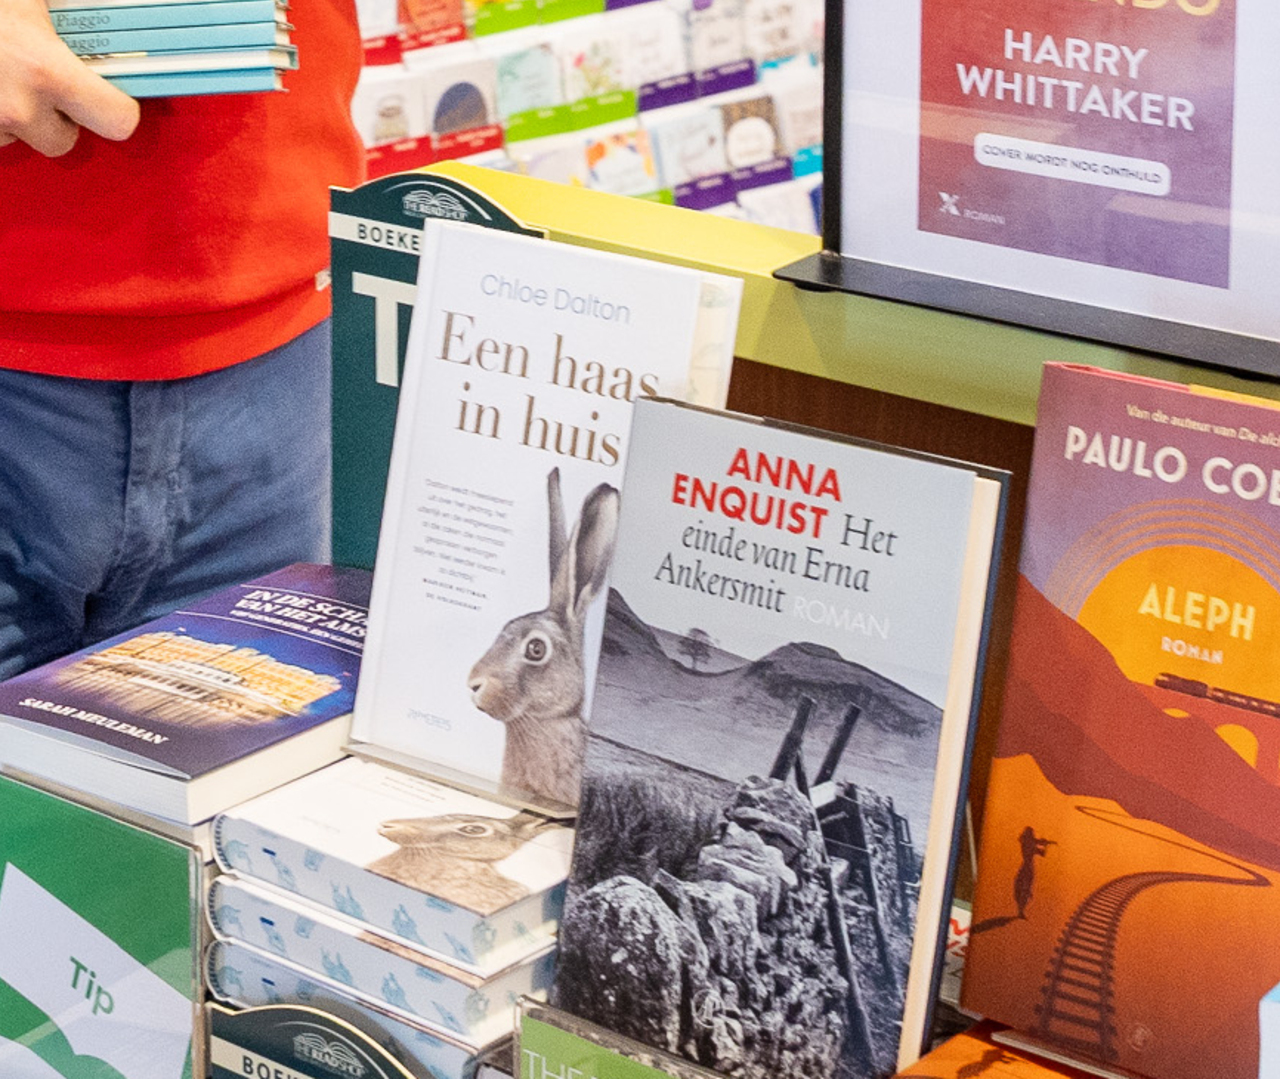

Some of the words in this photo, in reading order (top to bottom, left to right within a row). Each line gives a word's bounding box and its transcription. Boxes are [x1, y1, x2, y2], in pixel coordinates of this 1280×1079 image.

[56, 13, 110, 30] Piaggio
[1005, 28, 1149, 80] HARRY
[956, 63, 1195, 131] WHITTAKER
[982, 144, 1021, 160] COVER
[1024, 152, 1068, 168] WORDT
[1071, 159, 1099, 174] NOG
[1101, 164, 1162, 185] ONTHULD
[480, 274, 548, 306] Chloe
[554, 287, 631, 324] Dalton
[436, 310, 531, 379] Een
[549, 333, 660, 404] haas
[455, 380, 501, 440] in
[519, 393, 620, 467] huis
[1126, 404, 1150, 419] Van
[1152, 409, 1168, 423] de
[1170, 414, 1211, 432] auteur
[1214, 423, 1237, 437] van
[1238, 427, 1259, 442] De
[727, 447, 843, 502] ANNA
[1064, 425, 1188, 482] PAULO
[672, 473, 829, 539] ENQUIST
[841, 513, 898, 557] Het
[682, 520, 747, 561] einde
[752, 542, 797, 574] van
[802, 546, 870, 592] Erna
[242, 589, 281, 601] IN
[274, 594, 316, 608] DE
[274, 607, 328, 623] HET
[655, 552, 786, 613] Ankersmit
[792, 596, 891, 640] ROMAN
[1138, 582, 1256, 640] ALEPH
[1161, 636, 1223, 664] ROMAN
[19, 698, 78, 716] SARAH
[73, 710, 170, 744] MEULEMAN
[70, 956, 115, 1016] Tip
